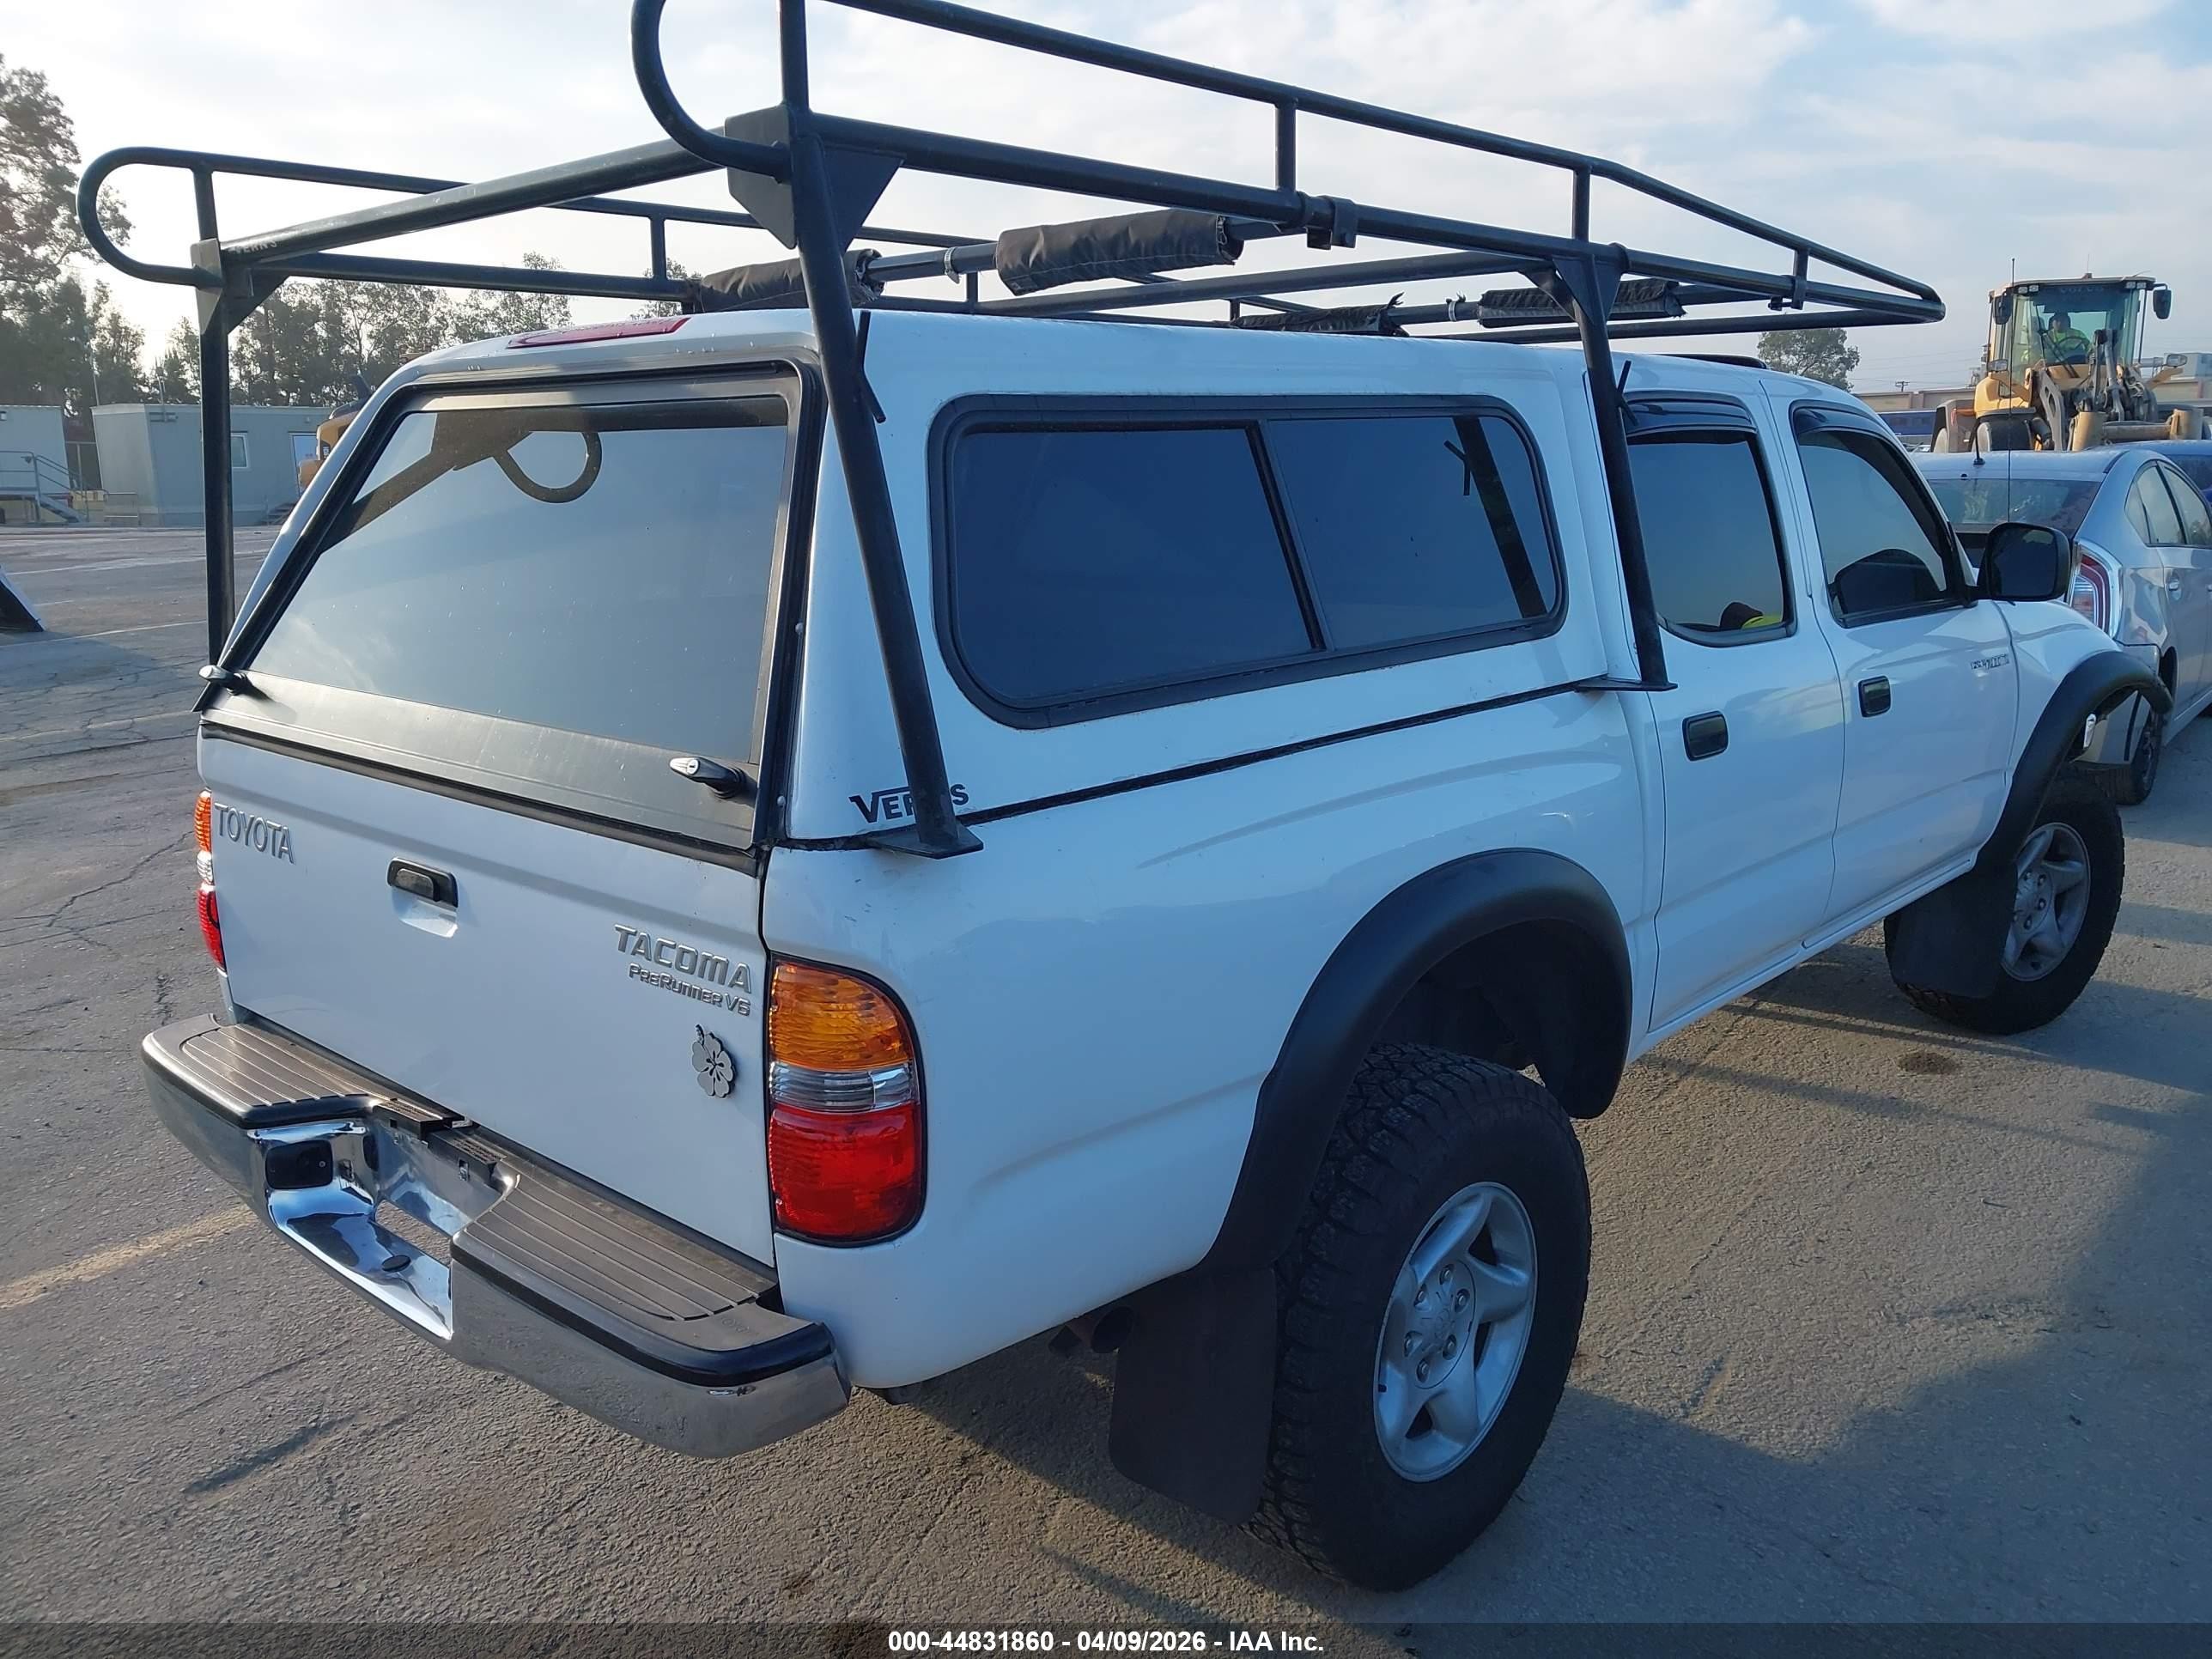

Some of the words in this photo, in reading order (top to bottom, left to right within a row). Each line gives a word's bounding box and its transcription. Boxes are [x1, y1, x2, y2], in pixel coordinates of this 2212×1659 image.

[214, 802, 295, 865] TOYOTA
[614, 924, 752, 994] TACOMA
[724, 993, 751, 1017] V6
